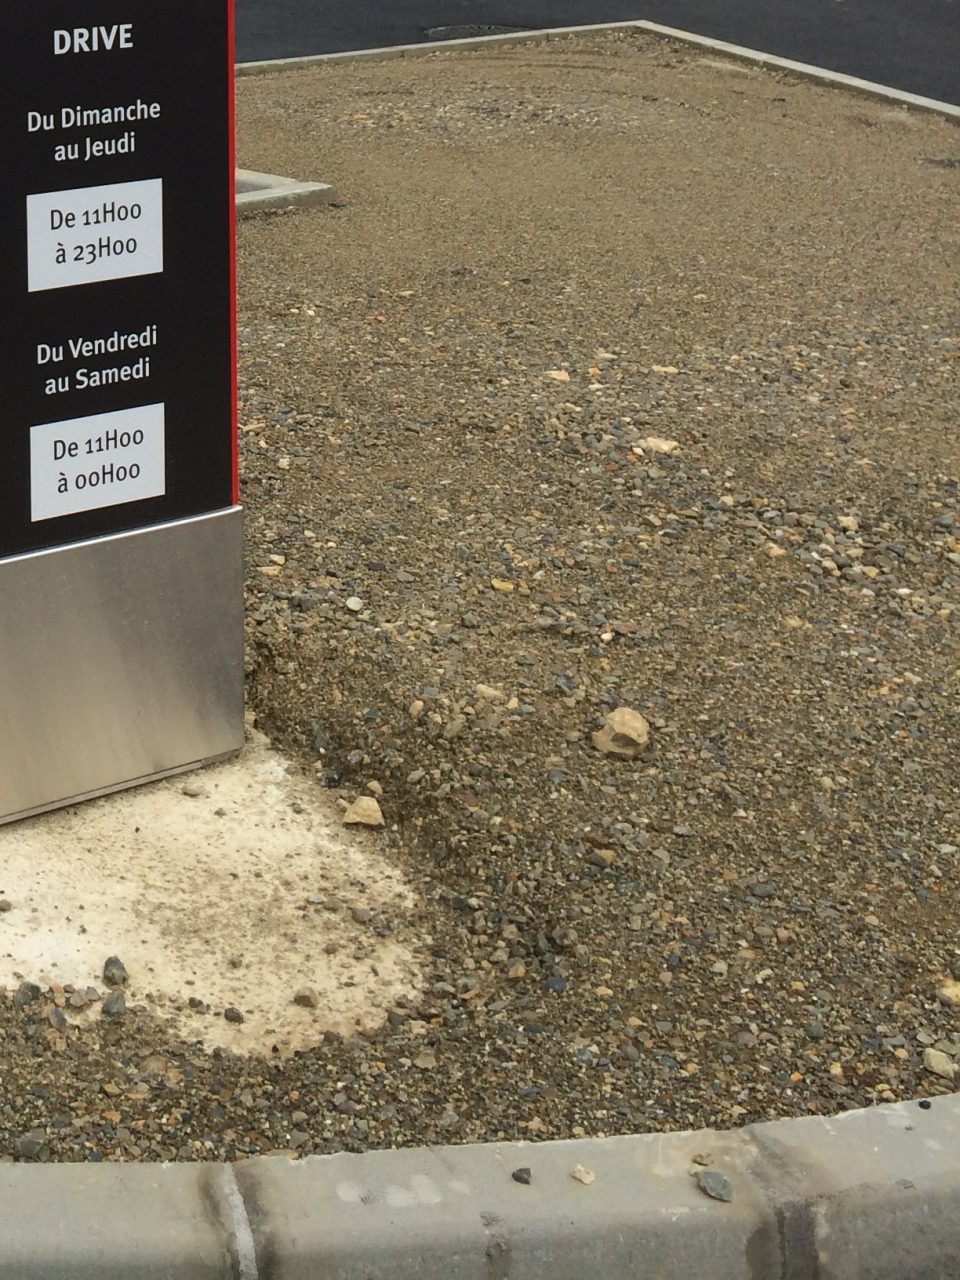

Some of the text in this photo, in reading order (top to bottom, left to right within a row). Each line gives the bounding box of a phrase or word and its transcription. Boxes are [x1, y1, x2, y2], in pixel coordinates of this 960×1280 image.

[53, 23, 134, 55] DRIVE
[27, 99, 161, 132] Du Dimanche
[54, 131, 135, 162] au Jeudi
[50, 209, 76, 231] De
[55, 242, 67, 265] à
[37, 324, 157, 365] Du Vendredi
[45, 356, 150, 395] au Samedi
[53, 439, 79, 461] De
[57, 471, 69, 494] à
